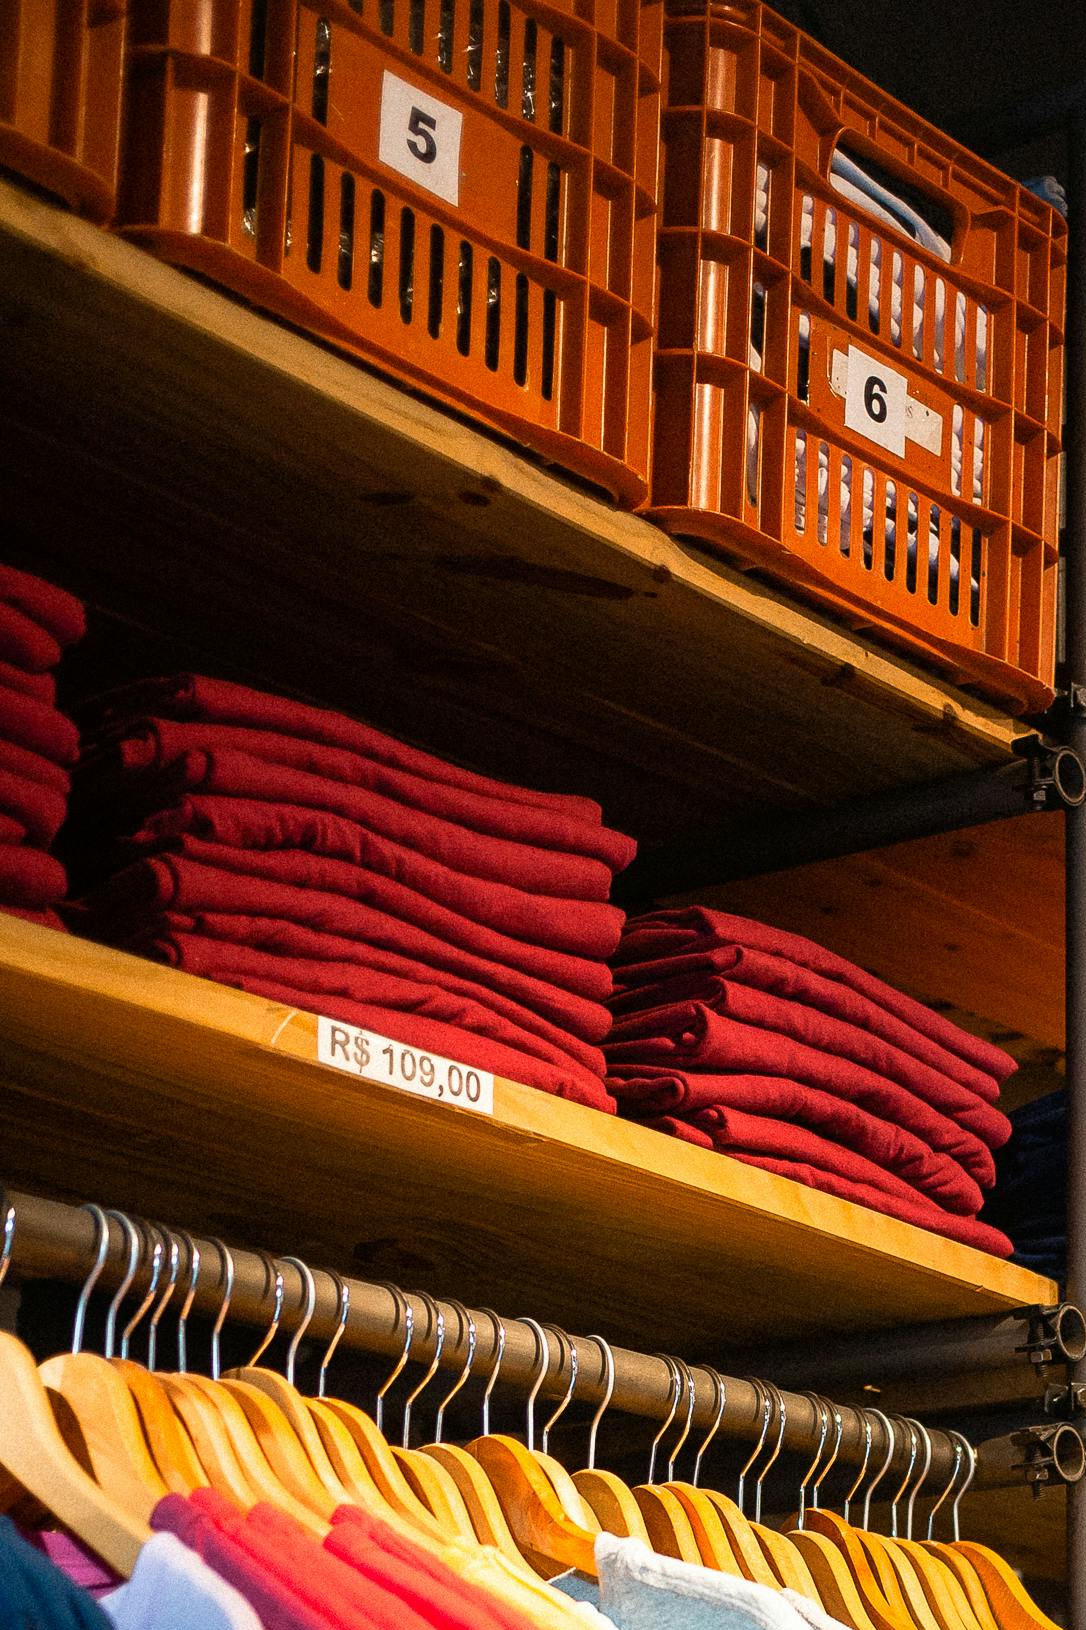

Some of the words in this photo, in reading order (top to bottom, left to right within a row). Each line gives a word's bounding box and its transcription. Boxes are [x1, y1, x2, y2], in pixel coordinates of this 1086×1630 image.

[407, 105, 437, 164] 5
[863, 375, 888, 424] 6
[330, 1024, 371, 1074] R$
[382, 1043, 482, 1103] 109,00
